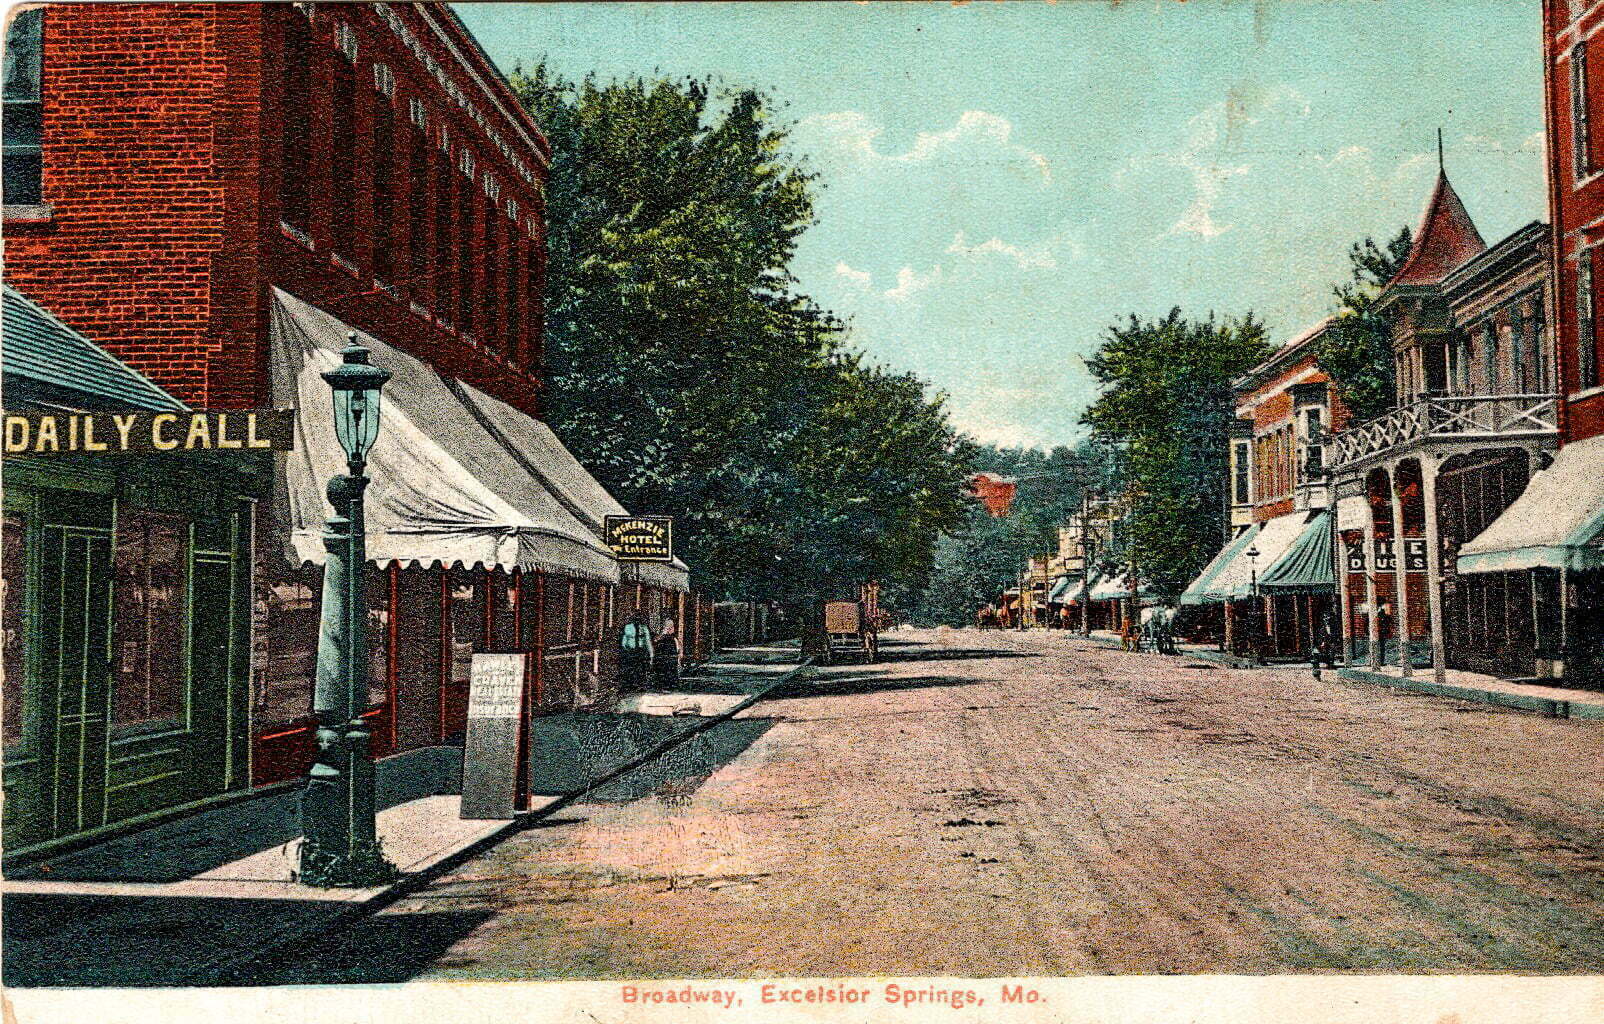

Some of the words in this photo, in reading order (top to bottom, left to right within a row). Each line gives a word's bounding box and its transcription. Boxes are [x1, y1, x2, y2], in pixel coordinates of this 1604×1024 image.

[5, 413, 136, 452] DAILY
[152, 413, 271, 450] CALL
[620, 535, 662, 545] HOTEL
[625, 545, 668, 554] Entrance
